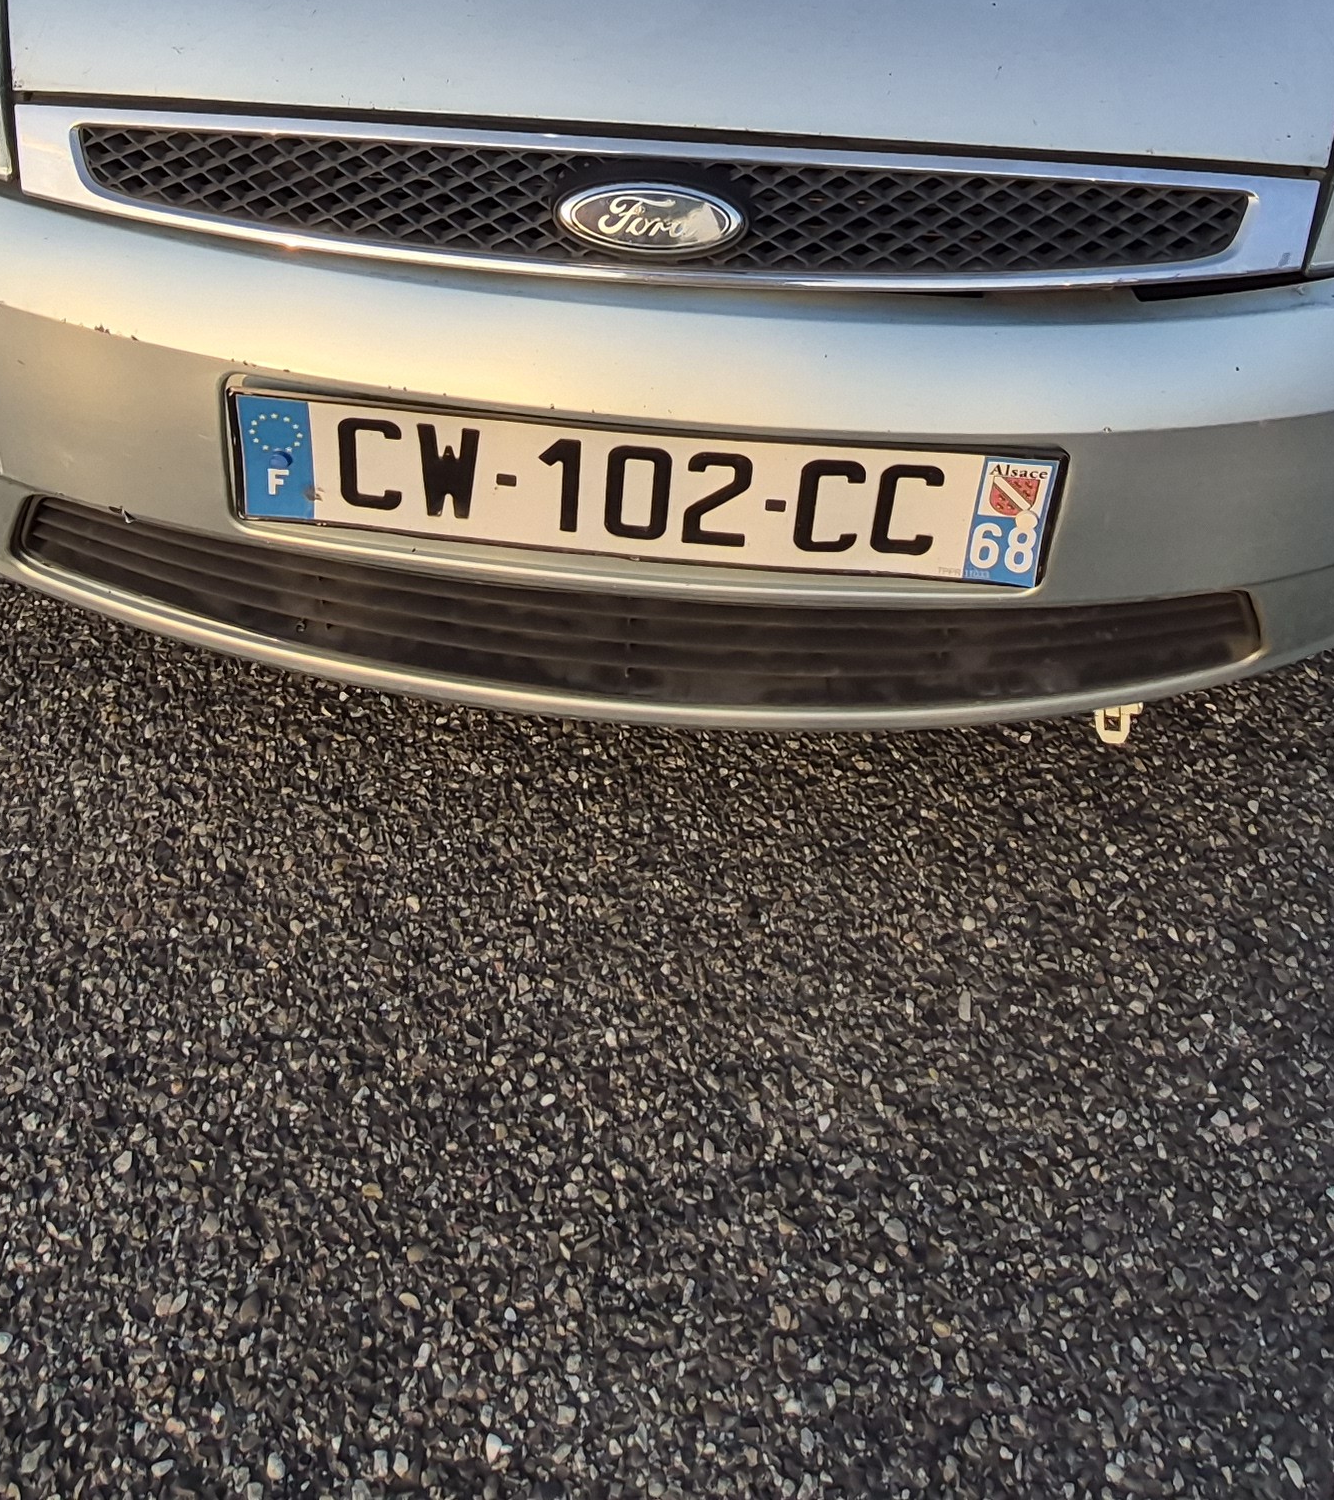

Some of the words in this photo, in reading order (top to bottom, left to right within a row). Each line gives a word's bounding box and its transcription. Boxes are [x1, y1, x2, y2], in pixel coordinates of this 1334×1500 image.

[267, 468, 290, 496] F
[337, 417, 945, 556] CW-102-CC
[989, 463, 1049, 480] Alsace
[969, 521, 1037, 574] 68
